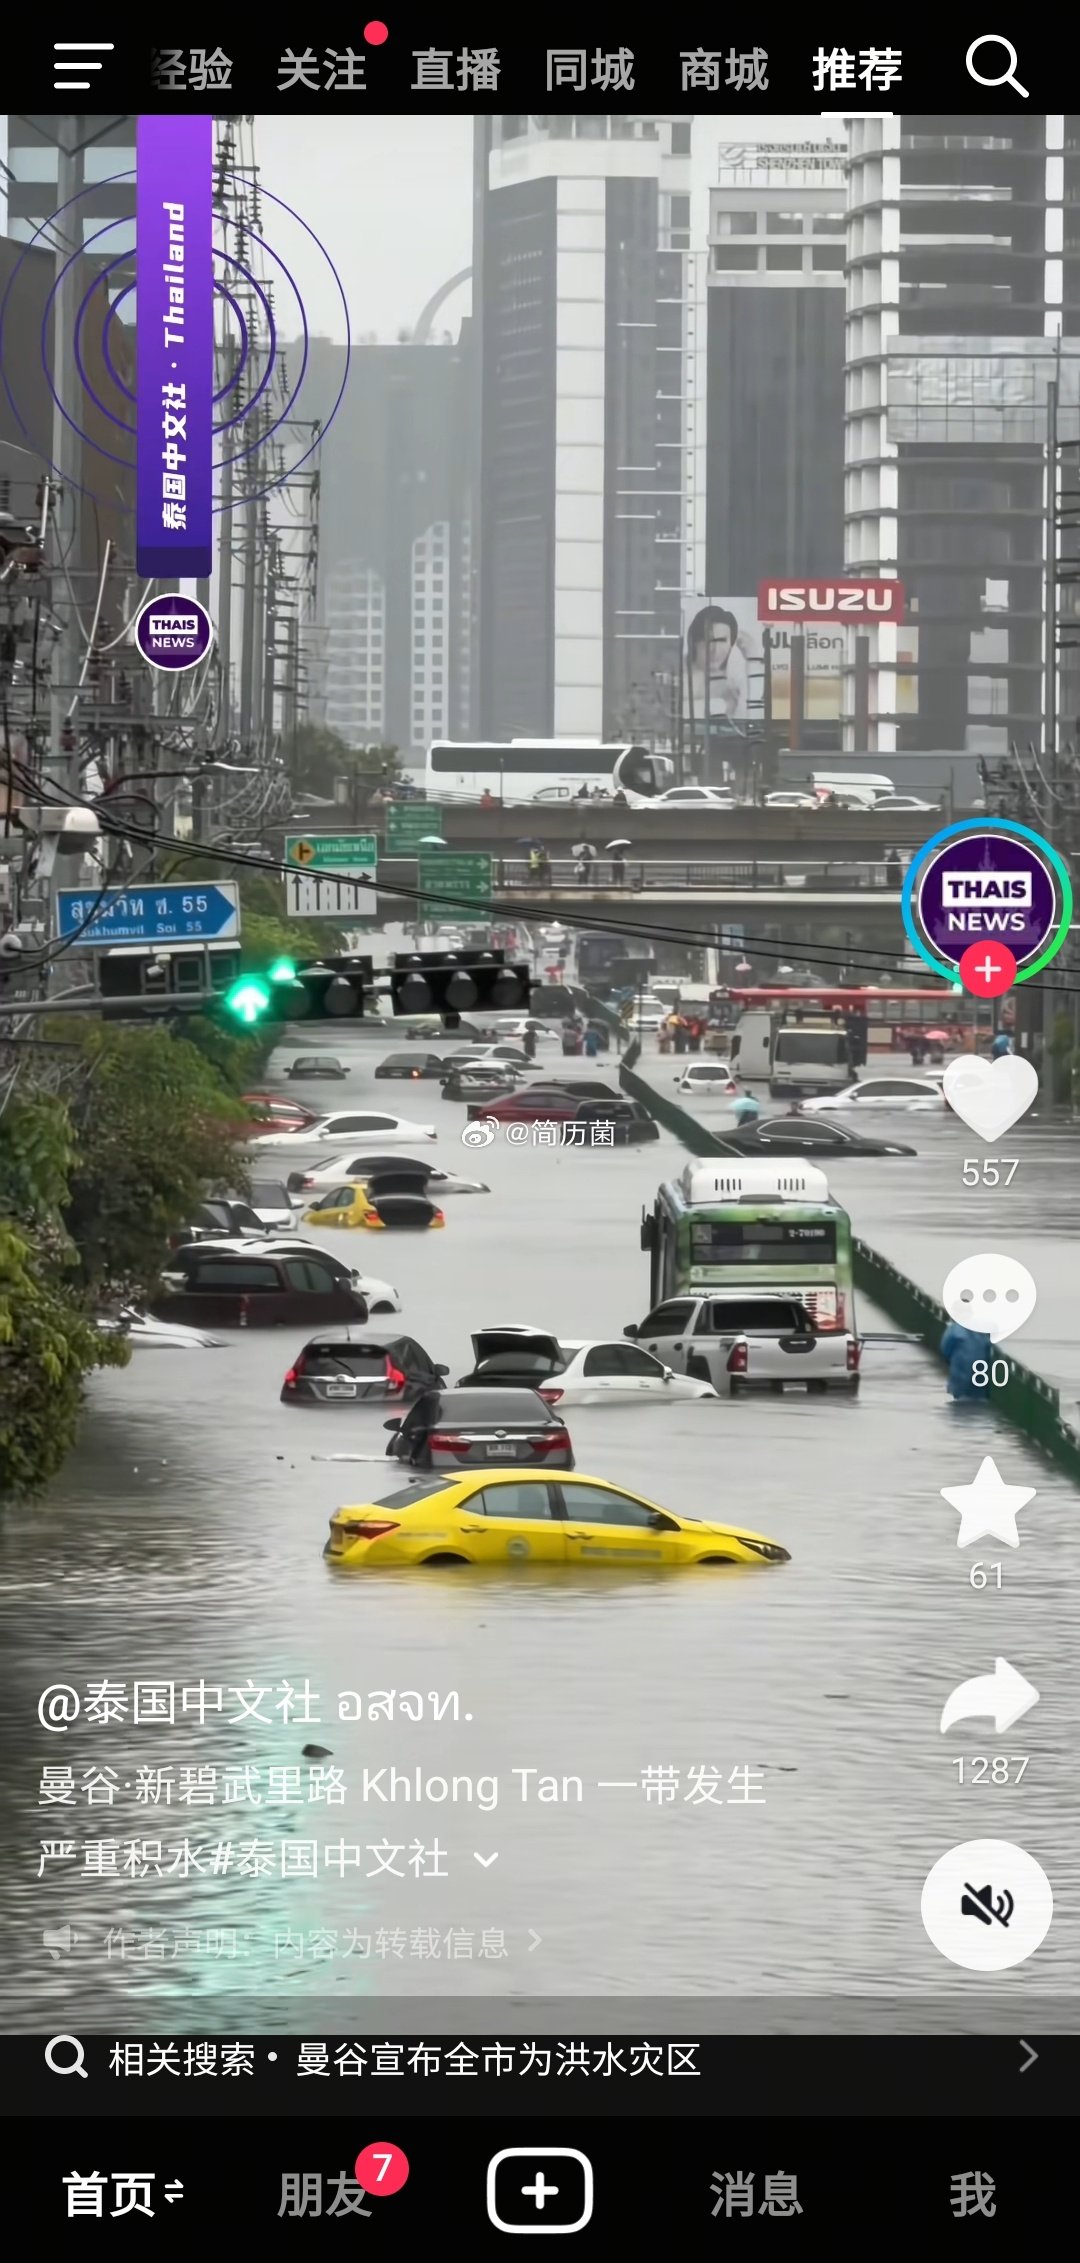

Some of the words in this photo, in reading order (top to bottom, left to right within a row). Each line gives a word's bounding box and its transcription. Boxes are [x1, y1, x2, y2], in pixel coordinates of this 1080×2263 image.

[768, 588, 892, 611] ISUZU
[182, 895, 207, 914] 55
[156, 922, 176, 934] Soi
[186, 920, 202, 933] 55
